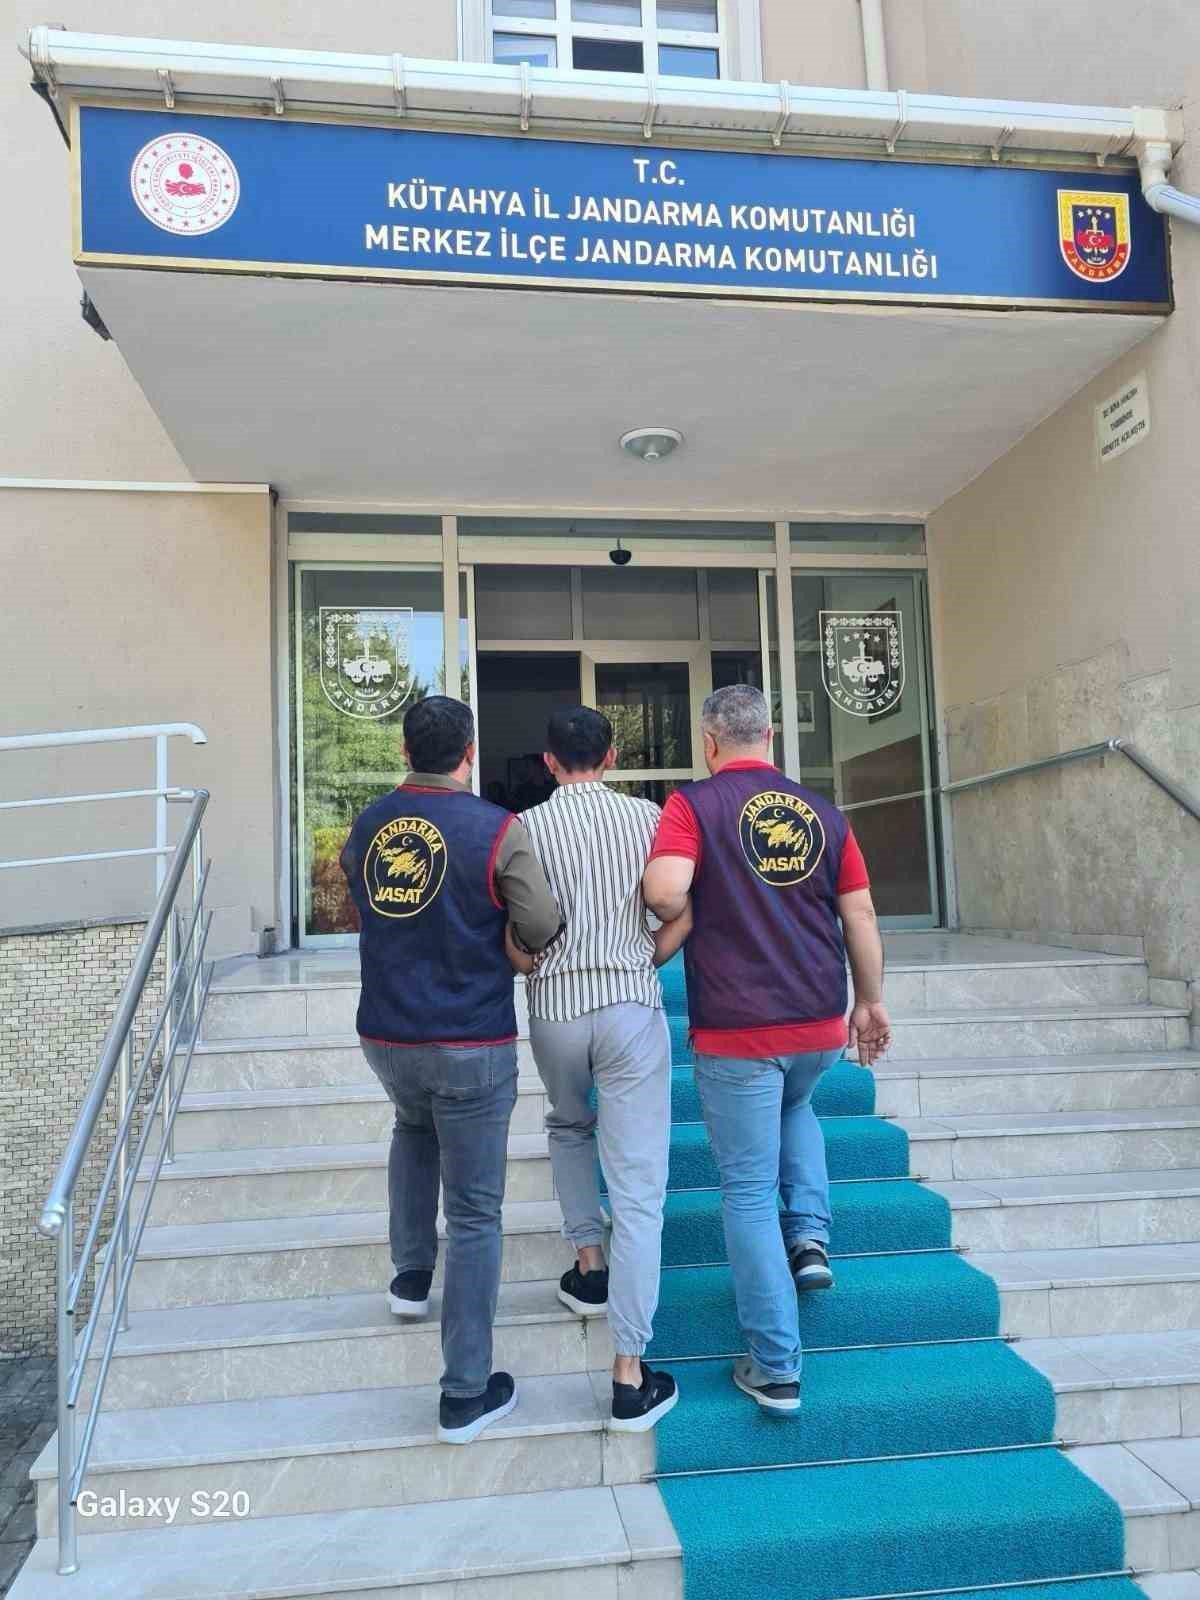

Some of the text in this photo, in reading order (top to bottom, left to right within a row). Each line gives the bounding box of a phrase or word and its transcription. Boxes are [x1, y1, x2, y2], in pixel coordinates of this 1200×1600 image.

[632, 158, 685, 186] T.C.
[386, 177, 917, 239] KÜTAHYA İL JANDARMA KOMUTANLIĞI
[364, 224, 938, 281] MERKEZ İLÇE JANDARMA KOMUTANLIĞI
[328, 680, 407, 713] JANDARMA
[829, 680, 899, 710] JANDARMA
[744, 794, 815, 824] JANDARMA
[375, 820, 443, 854] JANDARMA
[759, 856, 806, 872] JASAT
[374, 886, 424, 904] JASAT
